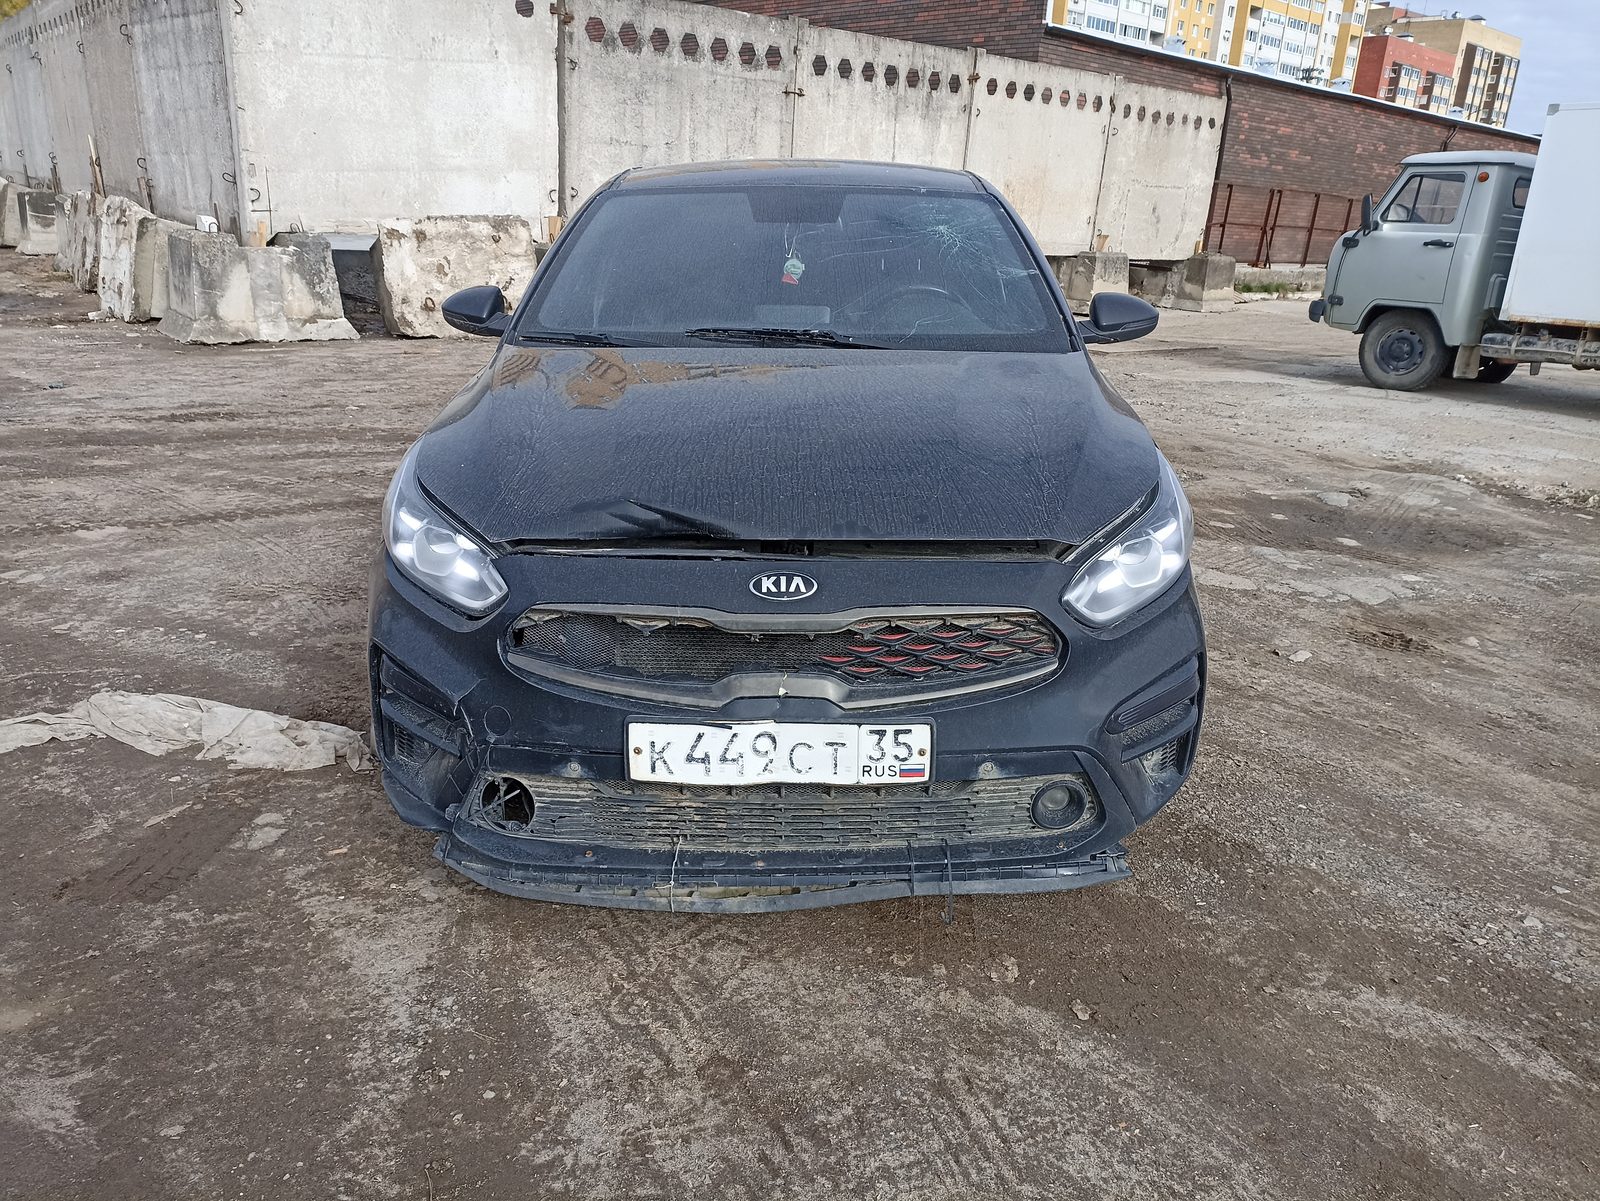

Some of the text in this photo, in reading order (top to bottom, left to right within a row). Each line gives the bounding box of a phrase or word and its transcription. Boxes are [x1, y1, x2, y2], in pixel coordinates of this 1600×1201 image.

[761, 575, 807, 593] KIA
[866, 728, 914, 763] 35
[861, 764, 898, 778] RUS
